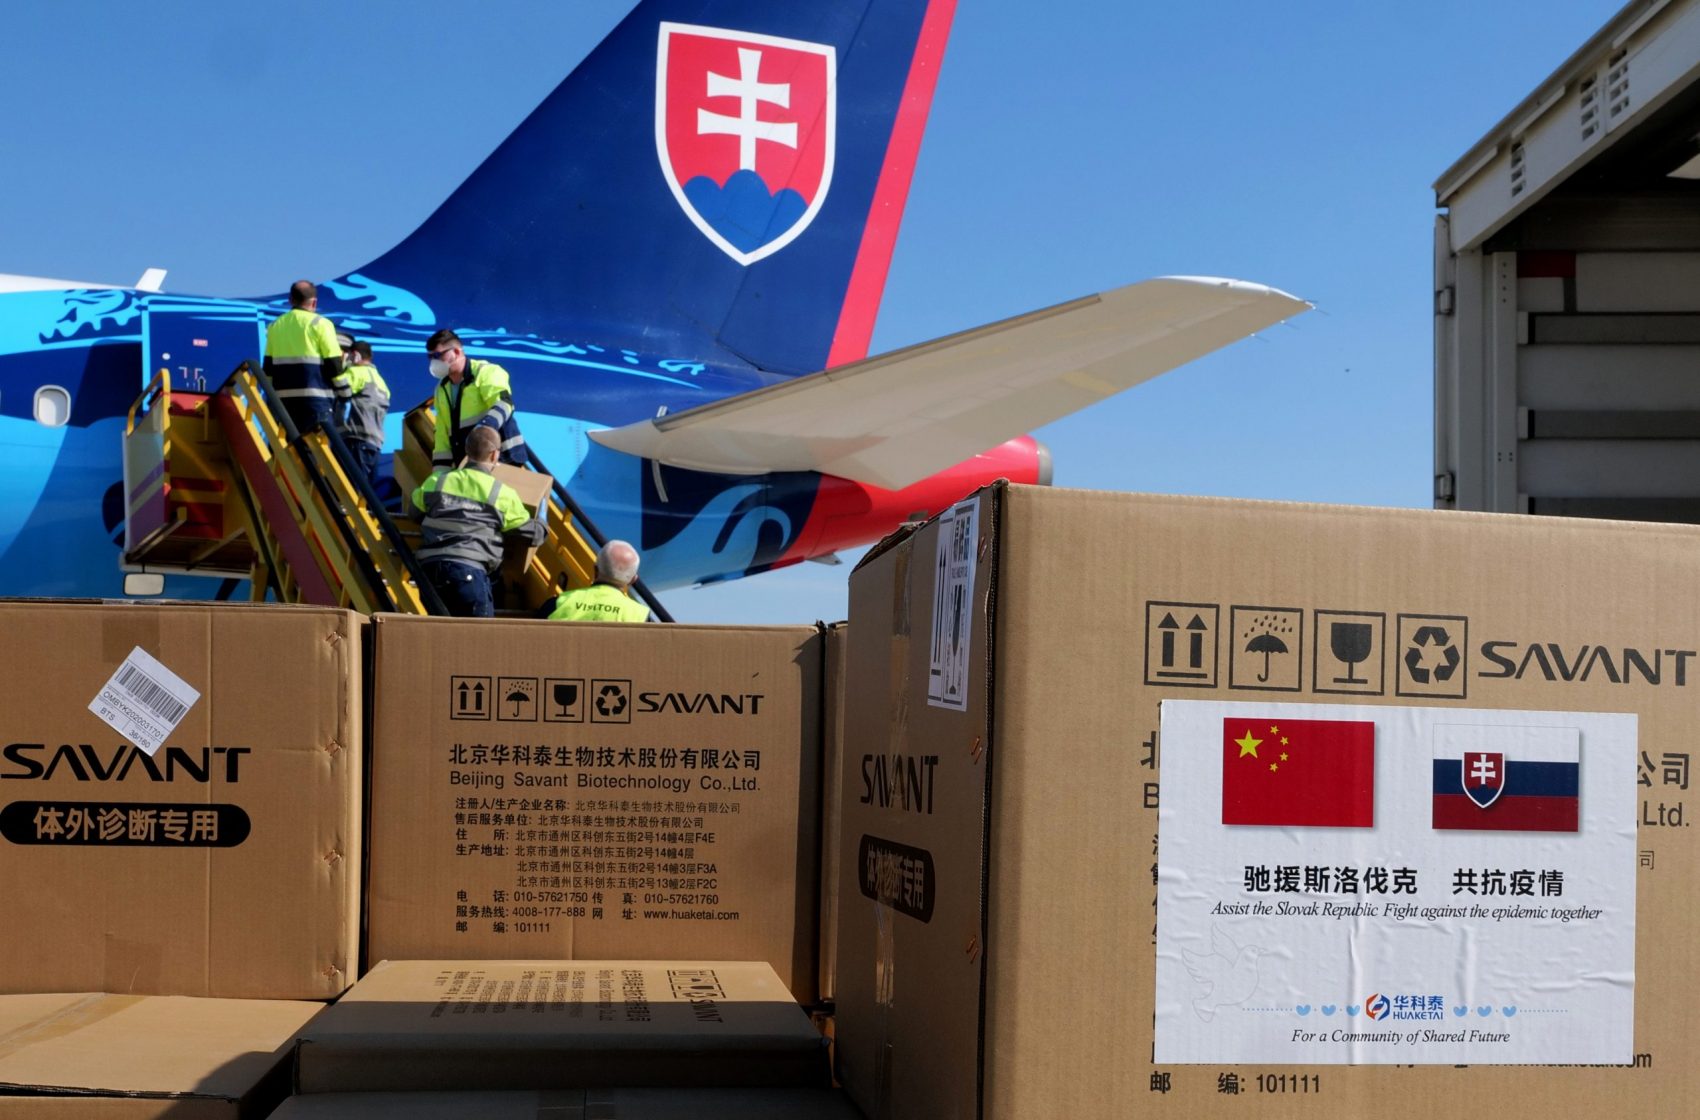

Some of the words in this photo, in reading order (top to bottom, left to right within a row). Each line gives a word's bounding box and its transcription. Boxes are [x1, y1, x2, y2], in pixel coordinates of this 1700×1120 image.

[575, 602, 620, 614] VISITOR
[1478, 640, 1697, 686] SAVANT
[637, 692, 764, 715] SAVANT
[100, 706, 116, 721] BTS
[0, 743, 252, 783] SAVANT
[449, 744, 760, 771] 北京华科泰生物技术股份有限公司
[450, 770, 504, 790] Beijing
[514, 772, 568, 787] Savant
[577, 773, 691, 793] Biotechnology
[700, 775, 761, 791] Co.,Ltd.
[860, 754, 938, 815] SAVANT
[575, 799, 741, 815] 北京华科泰生物技术股份有限公司
[33, 806, 219, 842] 体外诊断专用
[537, 814, 704, 829] 北京华科泰生物技术股份有限公司
[1244, 865, 1418, 894] 驰援斯洛伐克
[1452, 868, 1564, 897] 共抗疫情
[513, 891, 588, 903] 010-57621750
[644, 893, 719, 905] 010-57621760
[512, 906, 586, 917] 4008-177-888
[643, 909, 740, 920] www.huaketai.com
[1211, 901, 1250, 916] Assist
[1252, 901, 1273, 916] the
[1275, 902, 1320, 916] Slovak
[1322, 903, 1379, 920] Republic
[1383, 903, 1419, 920] Fight
[1420, 905, 1468, 921] against
[1469, 904, 1490, 919] the
[1492, 905, 1549, 922] epidemic
[1550, 906, 1603, 923] together
[514, 922, 550, 933] 101111
[1393, 995, 1443, 1010] 华科泰
[1393, 1011, 1443, 1020] HUAKETAI
[1292, 1029, 1316, 1042] For
[1319, 1033, 1327, 1042] a
[1331, 1029, 1402, 1045] Community
[1405, 1029, 1421, 1045] of
[1422, 1029, 1466, 1042] Shared
[1469, 1030, 1510, 1042] Future
[1256, 1074, 1320, 1093] 101111
